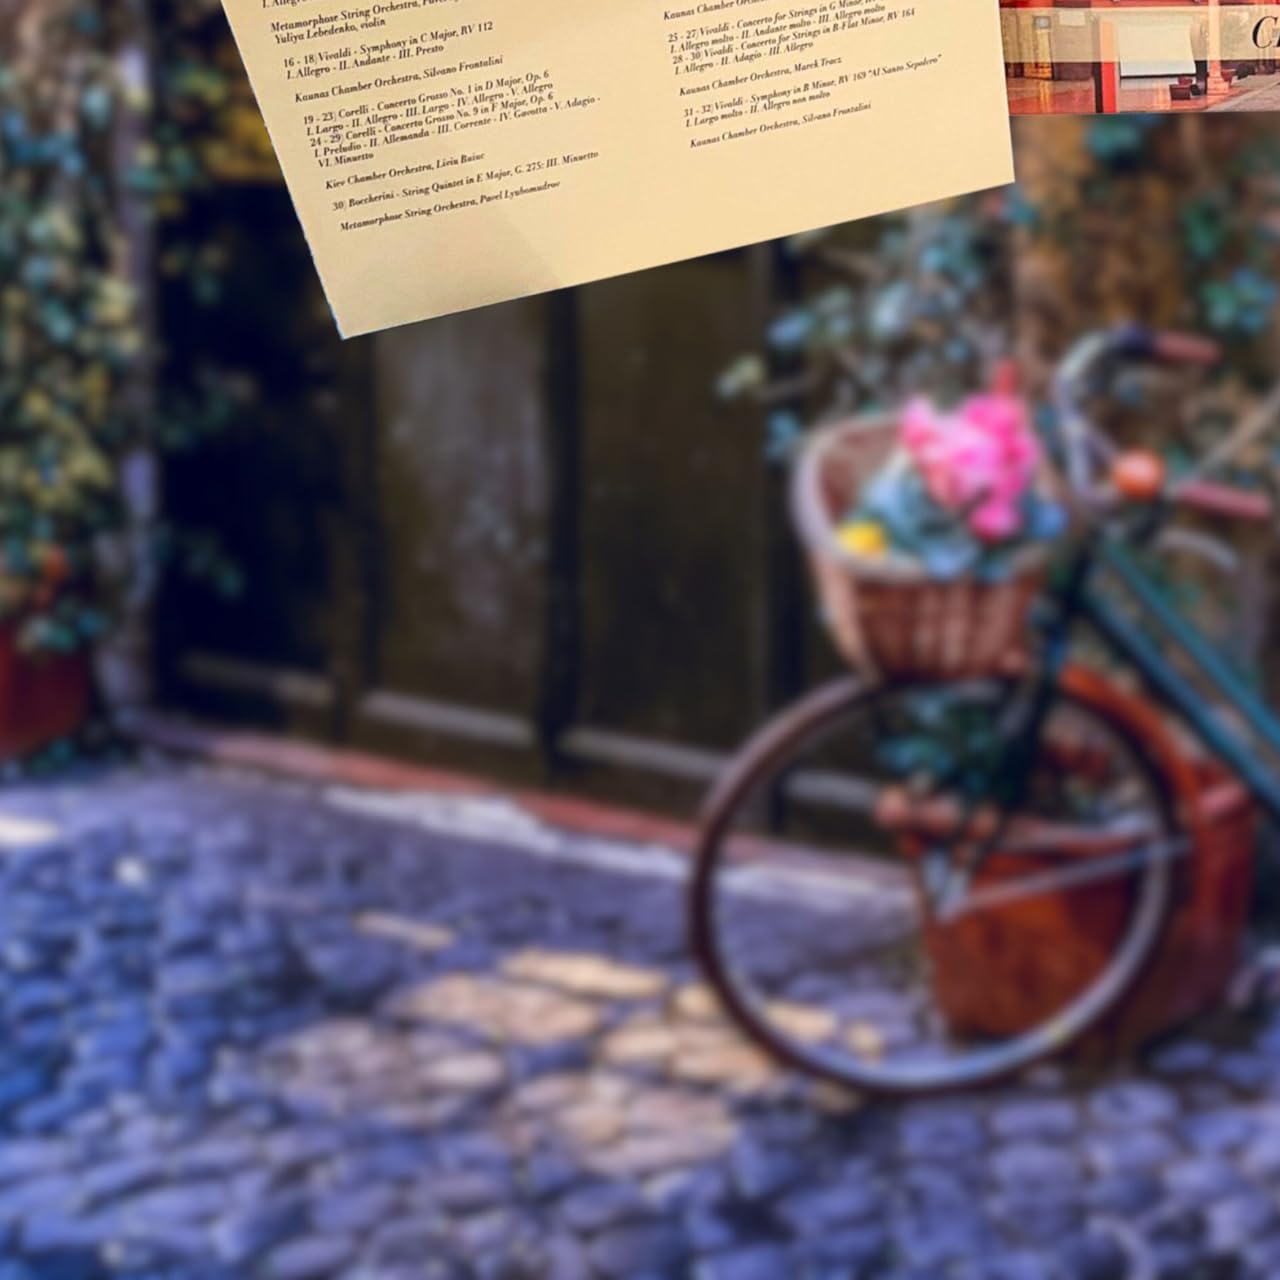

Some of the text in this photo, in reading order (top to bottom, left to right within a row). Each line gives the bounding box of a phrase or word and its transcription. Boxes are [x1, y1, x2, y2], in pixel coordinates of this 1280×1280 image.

[271, 14, 339, 32] Metamorphose
[340, 8, 371, 23] String
[663, 9, 695, 21] Kaunas
[696, 0, 735, 13] Chamber
[736, 8, 818, 29] Concerto Strings
[274, 32, 305, 44] Yuliya
[360, 16, 386, 29] violin
[360, 39, 408, 56] Symphony
[460, 24, 475, 36] RV
[478, 21, 493, 32] 112
[351, 52, 391, 68] Andante
[711, 75, 749, 89] Chamber
[794, 59, 819, 72] Marek
[295, 91, 330, 103] Kaunas
[331, 81, 373, 96] Chamber
[750, 89, 792, 106] Symphony
[338, 92, 449, 118] Corelli Concerto Grosso
[323, 104, 548, 156] Preludio Allemanda Corrente Gavotta
[722, 128, 758, 141] Chamber
[334, 153, 374, 165] Minuetto
[347, 171, 387, 185] Chamber
[348, 152, 599, 208] Boccherini String Quintet Minuetto
[404, 208, 432, 218] String
